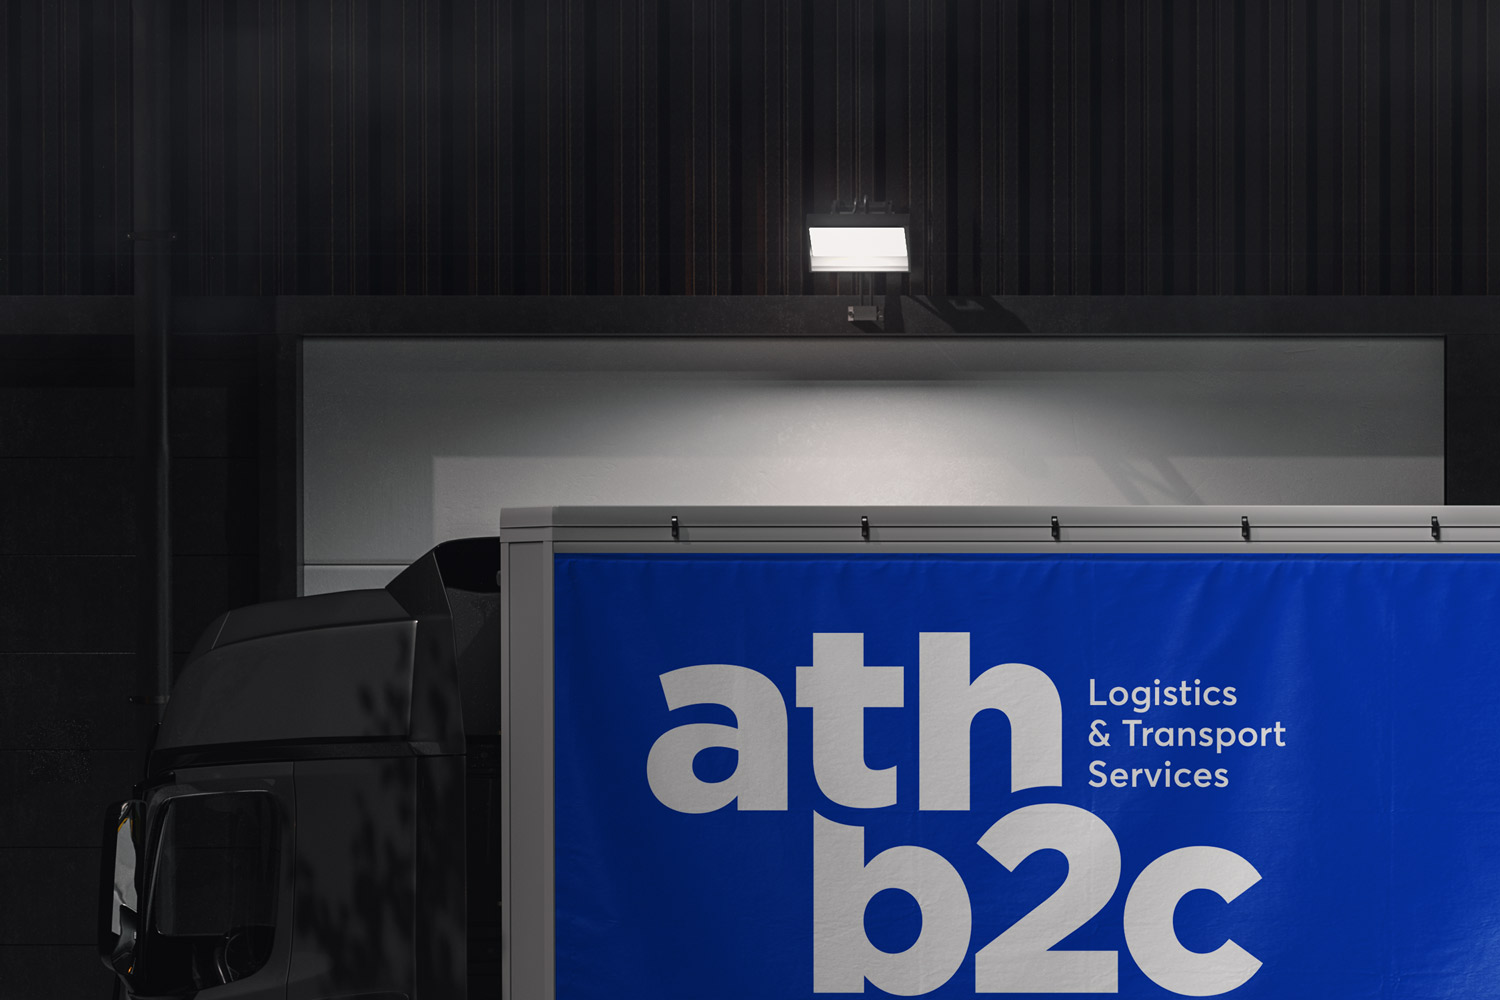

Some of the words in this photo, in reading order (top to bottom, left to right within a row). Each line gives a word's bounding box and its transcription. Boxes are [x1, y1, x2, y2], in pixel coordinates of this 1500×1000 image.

[1089, 678, 1238, 714] Logistics
[646, 631, 1063, 814] ath
[1088, 719, 1111, 747] &
[1121, 719, 1287, 754] Transport
[1088, 759, 1229, 788] Services
[813, 803, 1264, 997] b2c
